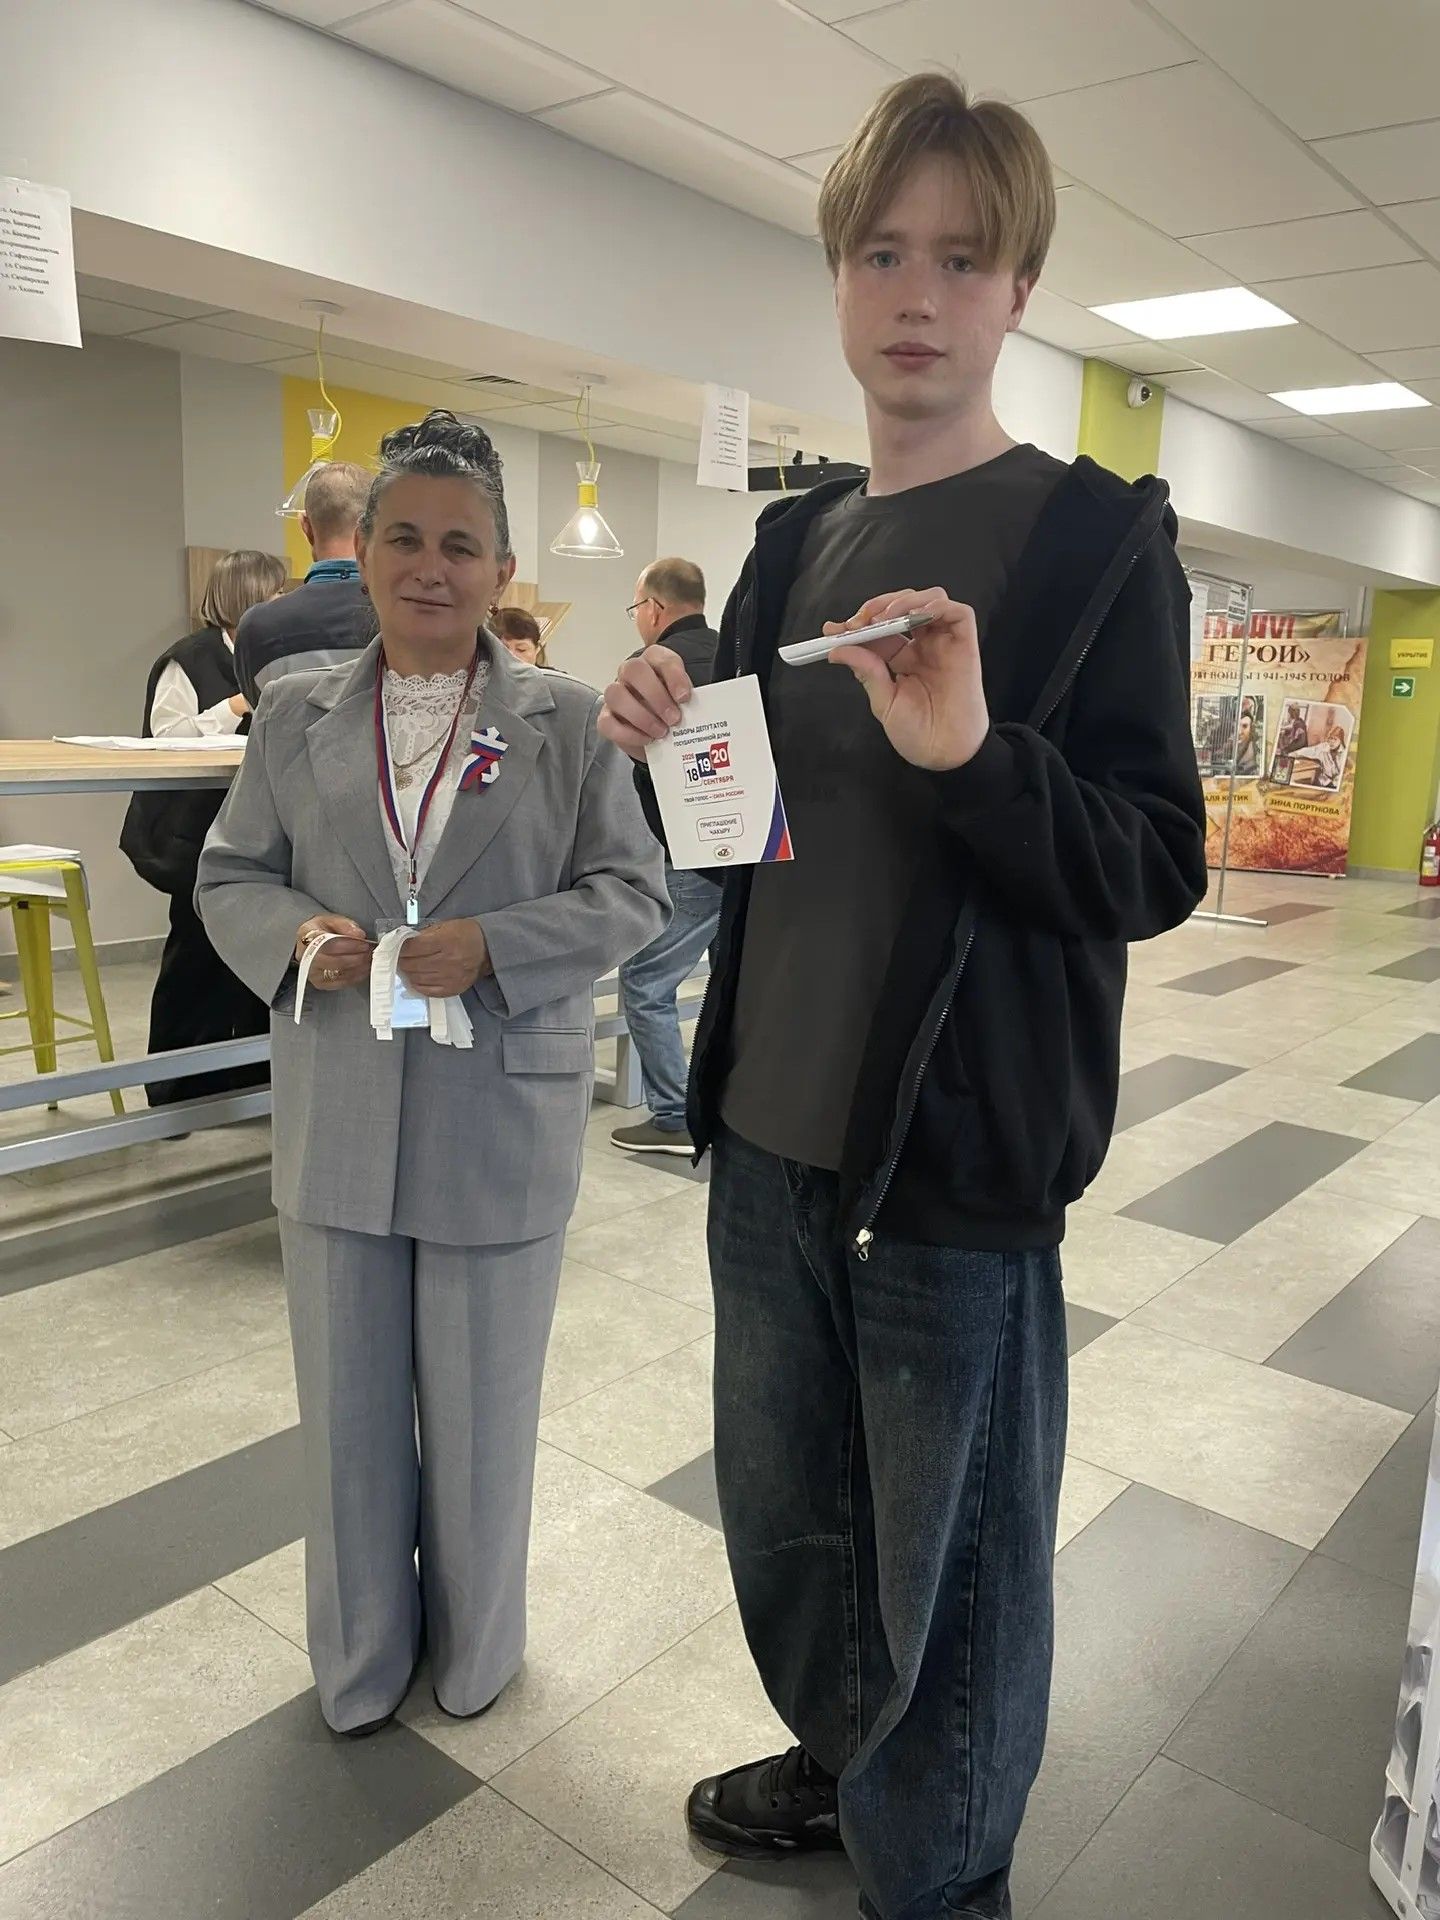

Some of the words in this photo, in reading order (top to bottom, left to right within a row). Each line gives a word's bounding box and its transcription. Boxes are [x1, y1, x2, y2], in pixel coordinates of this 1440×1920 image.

[1256, 671, 1307, 681] 1941-1945
[1310, 672, 1350, 682] ГОДОВ
[672, 727, 695, 737] ВЫБОРЫ
[696, 720, 728, 733] ДЕПУТАТОВ
[674, 734, 716, 747] ГОСУДАРСТВЕННОЙ
[686, 768, 699, 782] 18
[698, 757, 711, 773] 19
[711, 748, 728, 764] 20
[703, 775, 735, 786] СЕНТЯБРЯ
[1271, 798, 1291, 808] ЗИНА
[1293, 801, 1340, 815] ПОРТНОВА
[700, 818, 737, 829] ПРИГЛАШЕНИЕ
